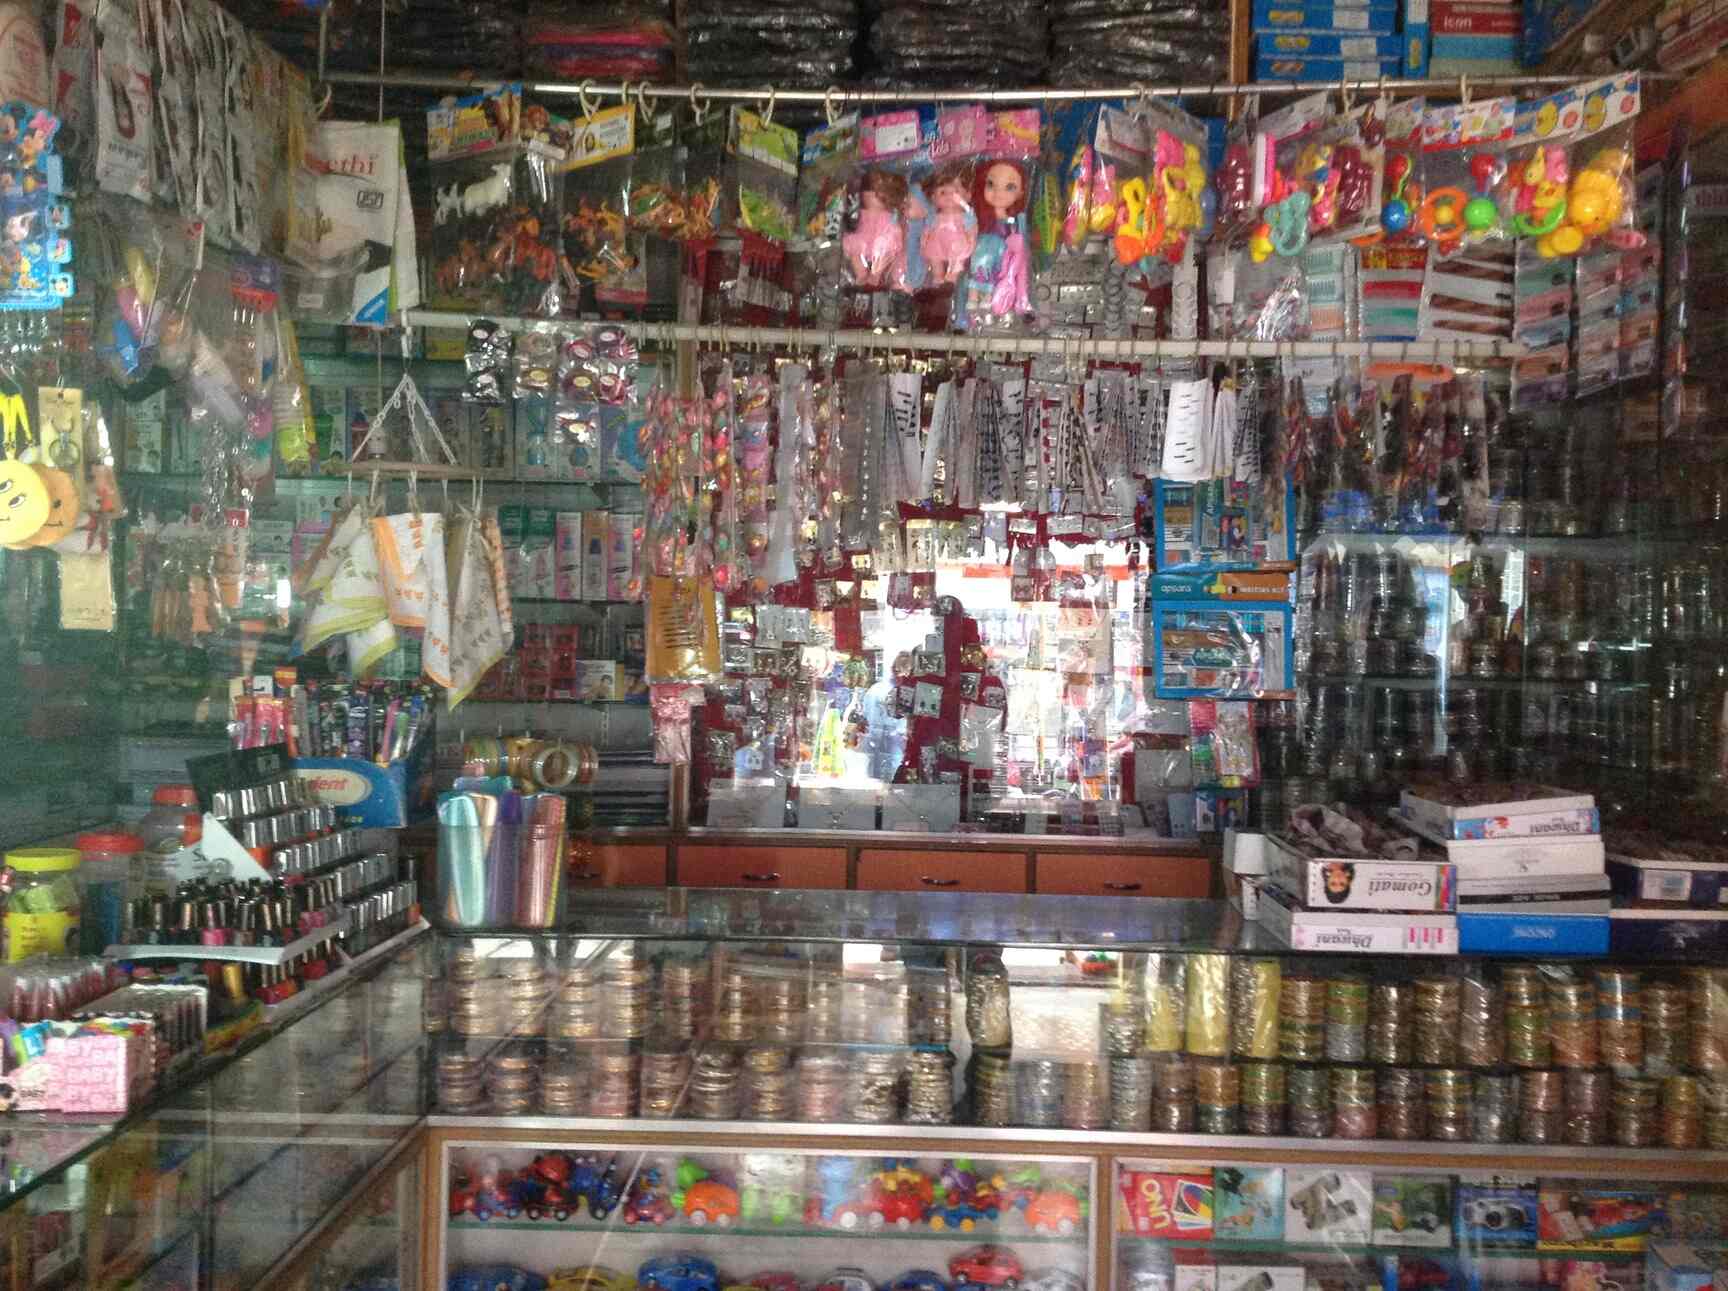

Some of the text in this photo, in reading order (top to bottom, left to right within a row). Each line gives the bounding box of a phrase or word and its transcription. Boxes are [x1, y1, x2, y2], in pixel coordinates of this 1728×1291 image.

[1368, 881, 1433, 896] Gomati
[1316, 933, 1375, 949] Dhwani
[1141, 1178, 1170, 1230] UNO
